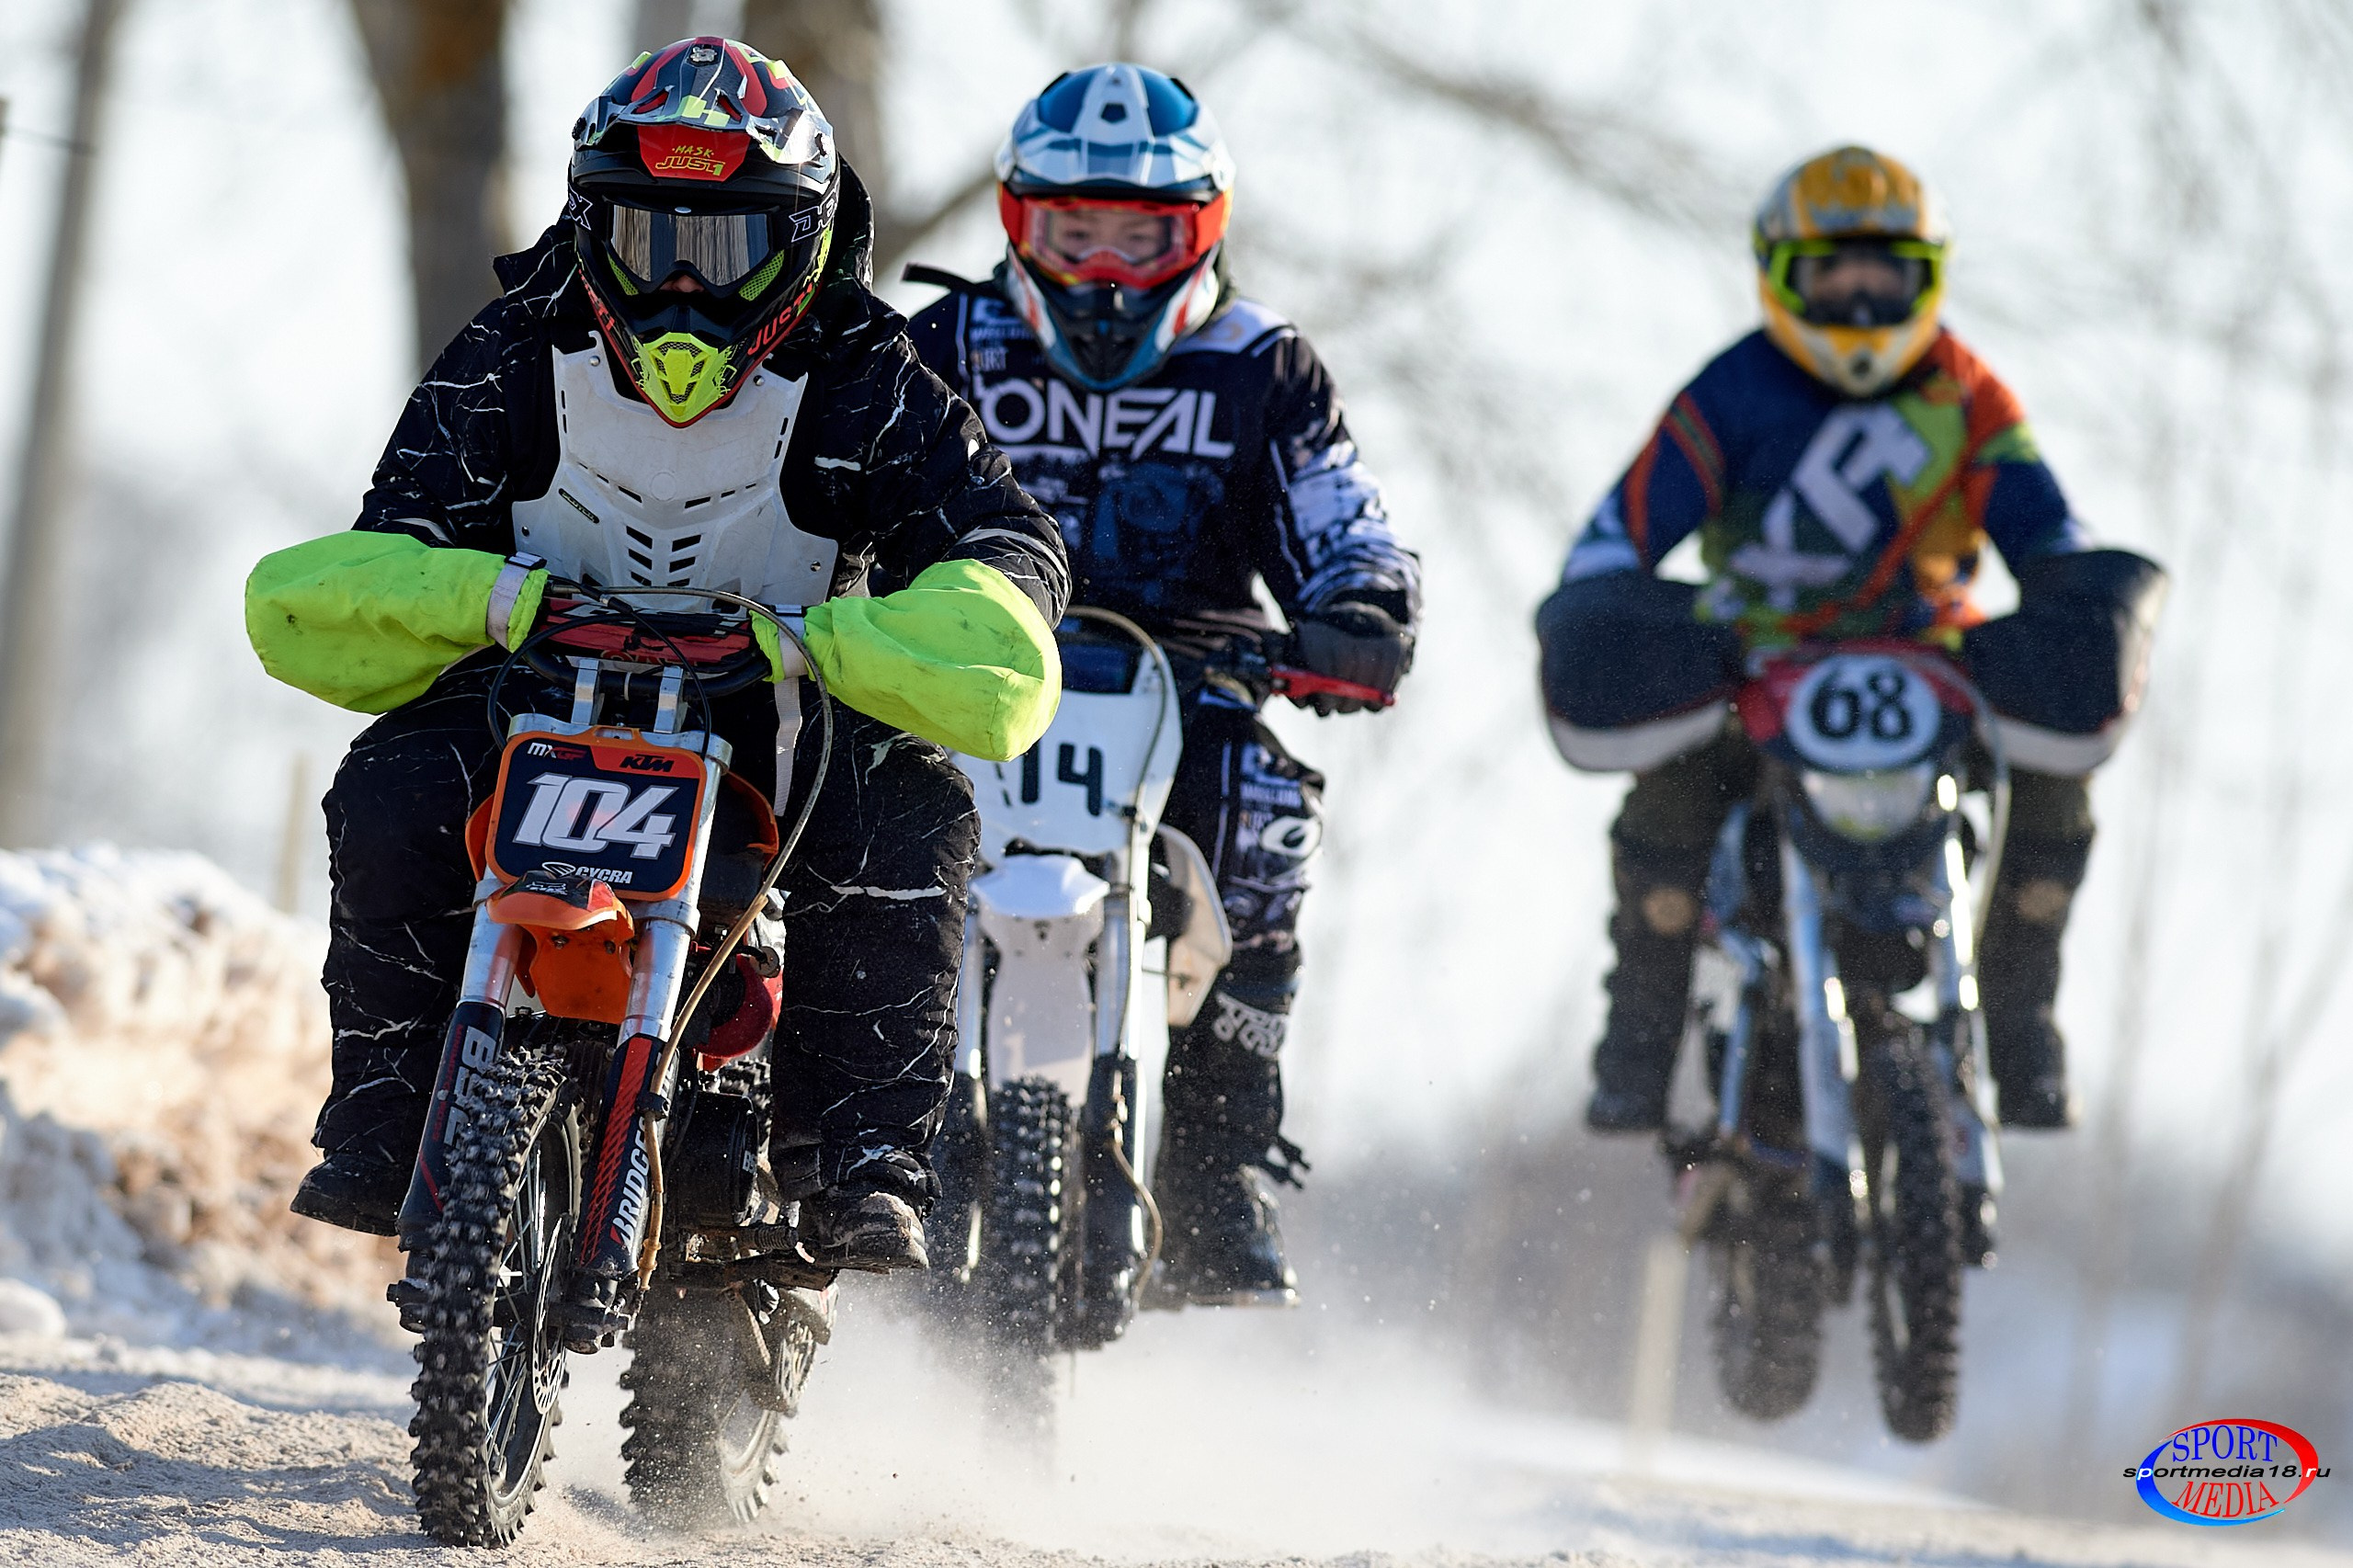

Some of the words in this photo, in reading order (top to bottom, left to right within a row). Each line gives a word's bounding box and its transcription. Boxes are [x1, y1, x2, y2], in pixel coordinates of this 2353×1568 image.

[655, 155, 725, 176] JUST1
[1811, 662, 1915, 741] 68
[620, 754, 675, 773] KTM
[513, 772, 680, 859] 104
[574, 866, 633, 884] CYCRA
